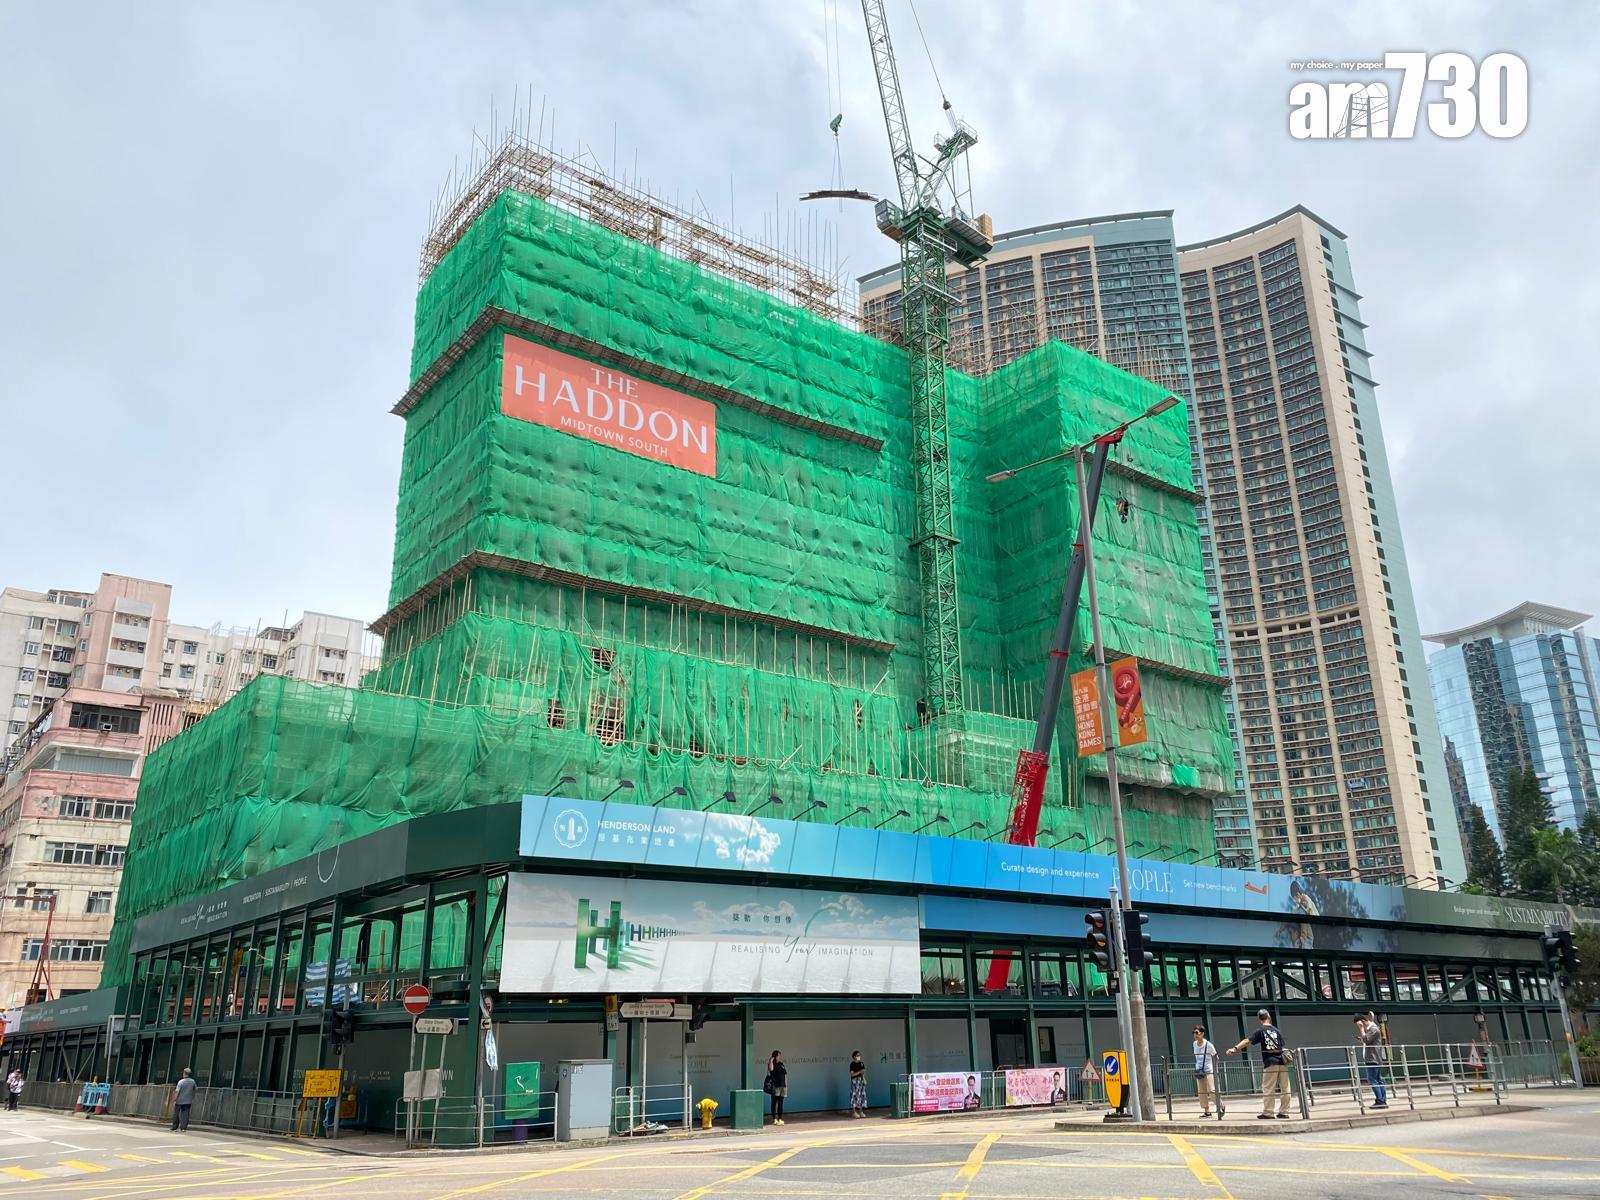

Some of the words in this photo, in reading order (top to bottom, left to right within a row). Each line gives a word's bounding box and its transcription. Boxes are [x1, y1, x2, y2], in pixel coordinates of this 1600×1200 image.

[591, 367, 638, 398] THE
[514, 364, 707, 454] HADDON
[560, 416, 624, 443] MIDTOWN
[628, 437, 668, 457] SOUTH
[1078, 720, 1095, 732] HONG
[1079, 729, 1096, 740] KONG
[1079, 737, 1101, 749] GAMES
[597, 820, 651, 833] HENDERSON
[653, 825, 676, 834] LAND
[1001, 862, 1025, 873] Curate
[1027, 866, 1049, 877] design
[1051, 868, 1063, 877] and
[1065, 870, 1099, 881] experience
[1503, 906, 1569, 927] SUSTAINABILITY
[730, 944, 781, 954] REALISING
[783, 935, 816, 963] Your
[818, 947, 873, 956] IMAGINATION
